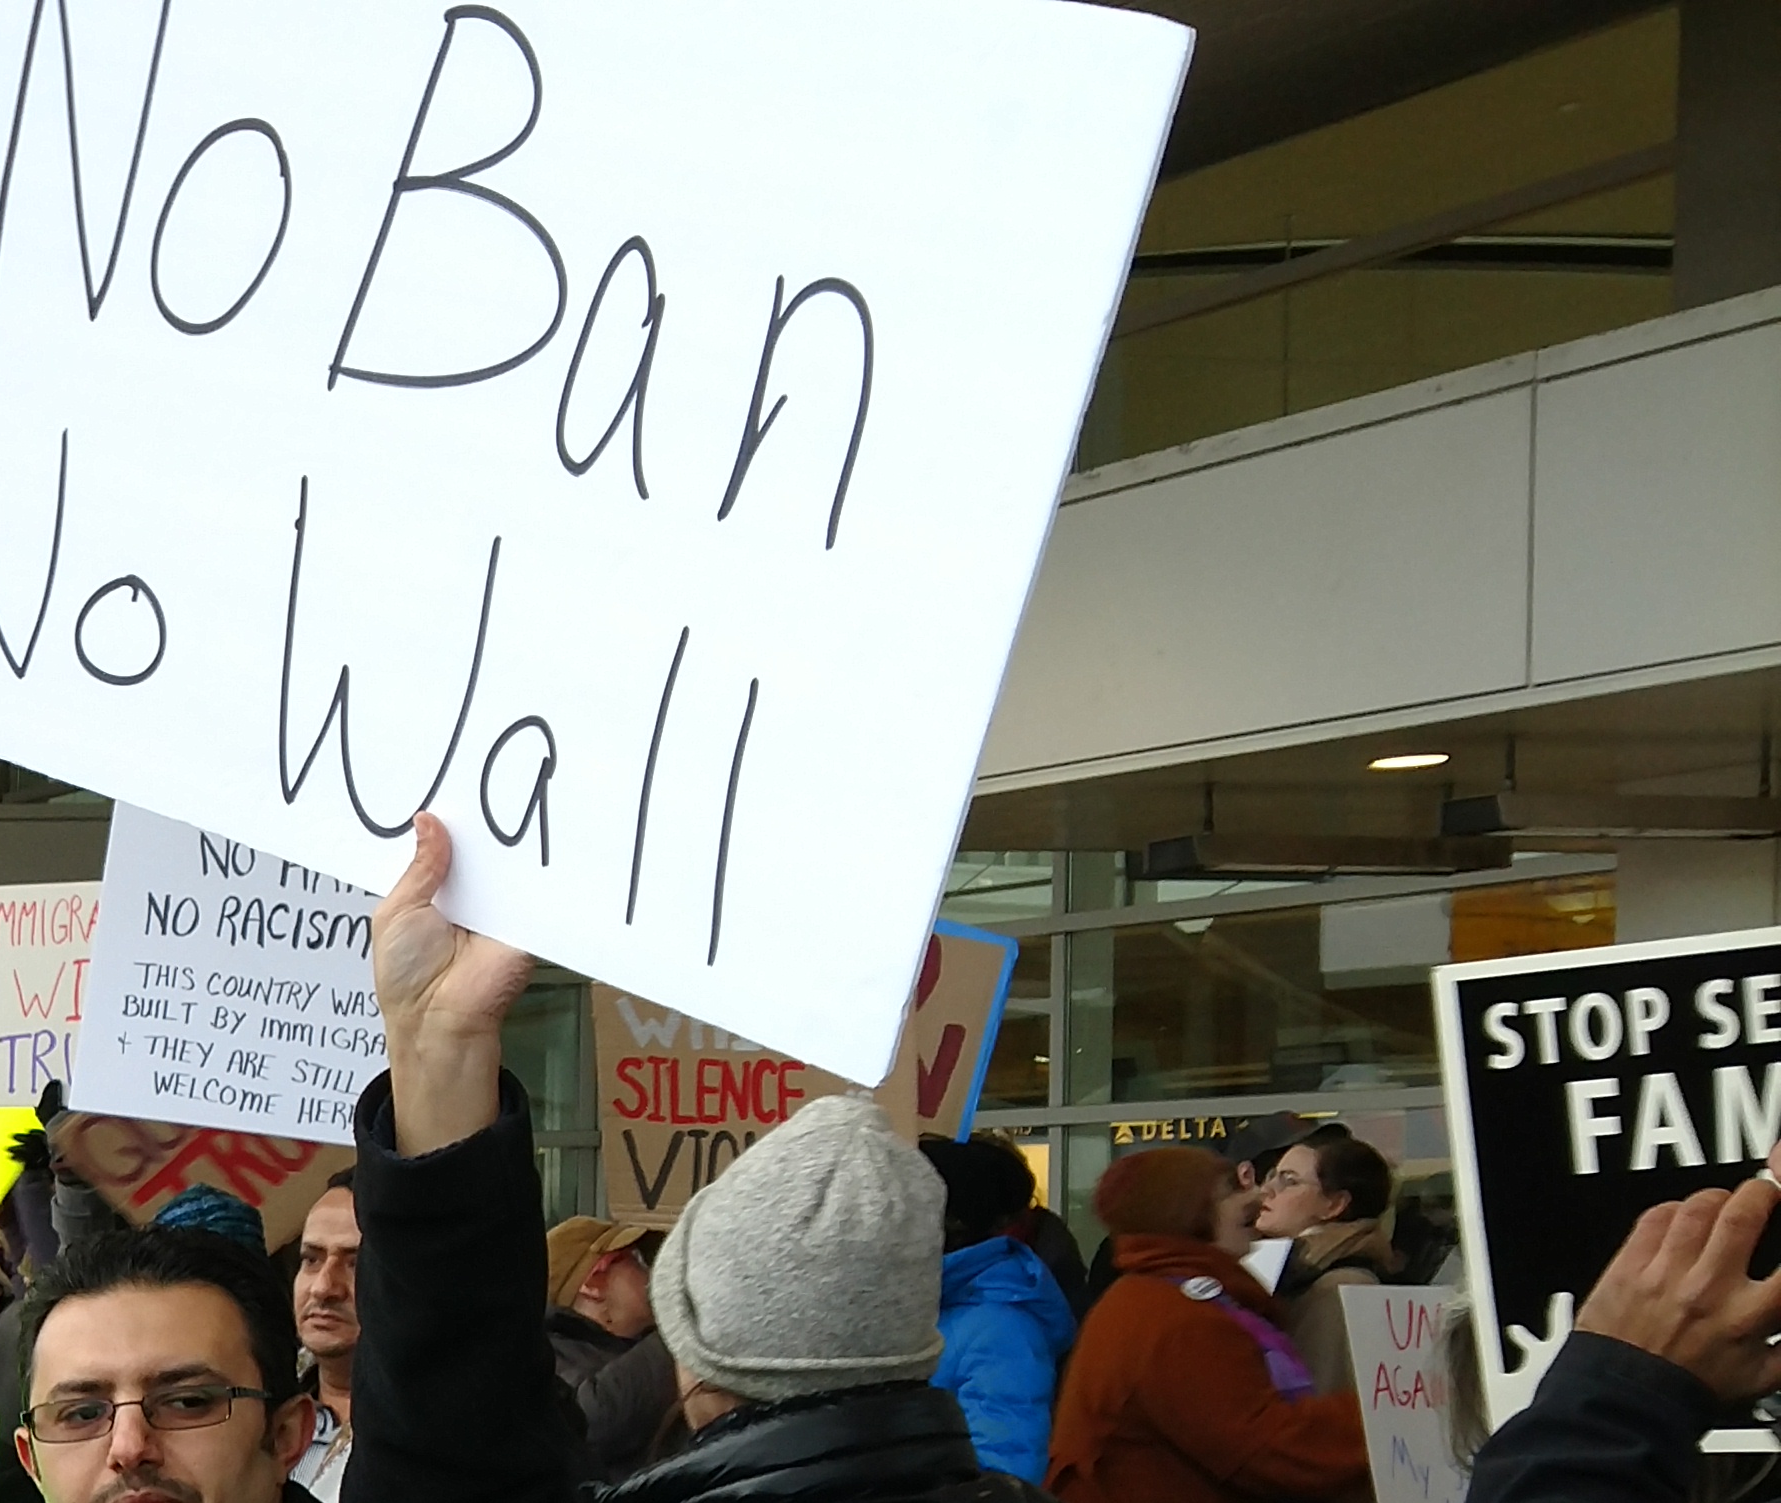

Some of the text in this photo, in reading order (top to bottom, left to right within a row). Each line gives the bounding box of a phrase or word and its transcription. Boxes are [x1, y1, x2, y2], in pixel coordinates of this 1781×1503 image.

[327, 3, 877, 552] Ban
[277, 475, 761, 968] Wall
[200, 831, 256, 879] NO
[144, 891, 374, 959] NO RACISM
[122, 994, 198, 1025] BUILT
[209, 1005, 247, 1035] BY
[134, 961, 380, 1018] THIS COUNTRY WAS
[1482, 974, 1781, 1070] STOP SE
[144, 1034, 215, 1069] THEY
[225, 1049, 277, 1081] ARE
[290, 1059, 360, 1097] STILL
[153, 1070, 283, 1114] WELCOME
[1141, 1116, 1227, 1141] DELTA
[622, 1128, 756, 1211] VIO
